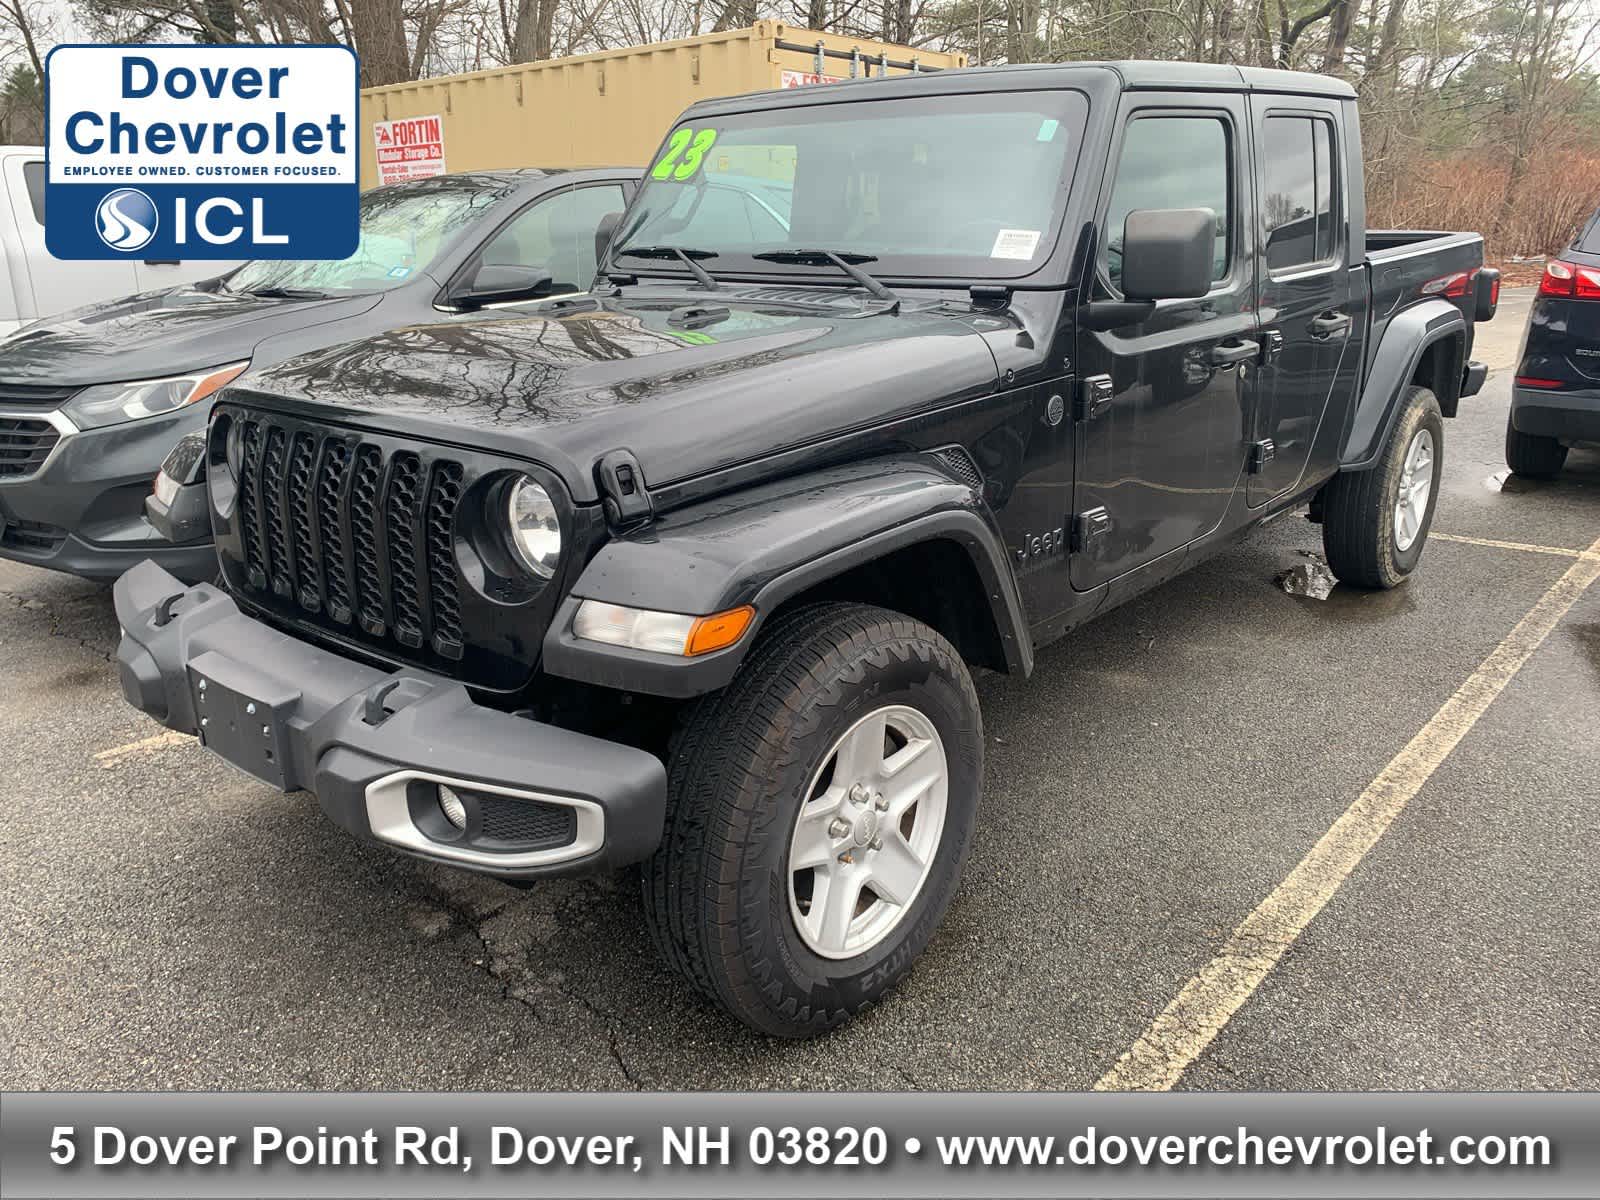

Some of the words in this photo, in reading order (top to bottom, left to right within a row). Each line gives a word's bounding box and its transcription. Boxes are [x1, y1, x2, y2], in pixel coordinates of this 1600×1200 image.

[392, 118, 440, 145] FORTIN
[651, 128, 717, 181] 23
[1016, 527, 1064, 561] Jeep
